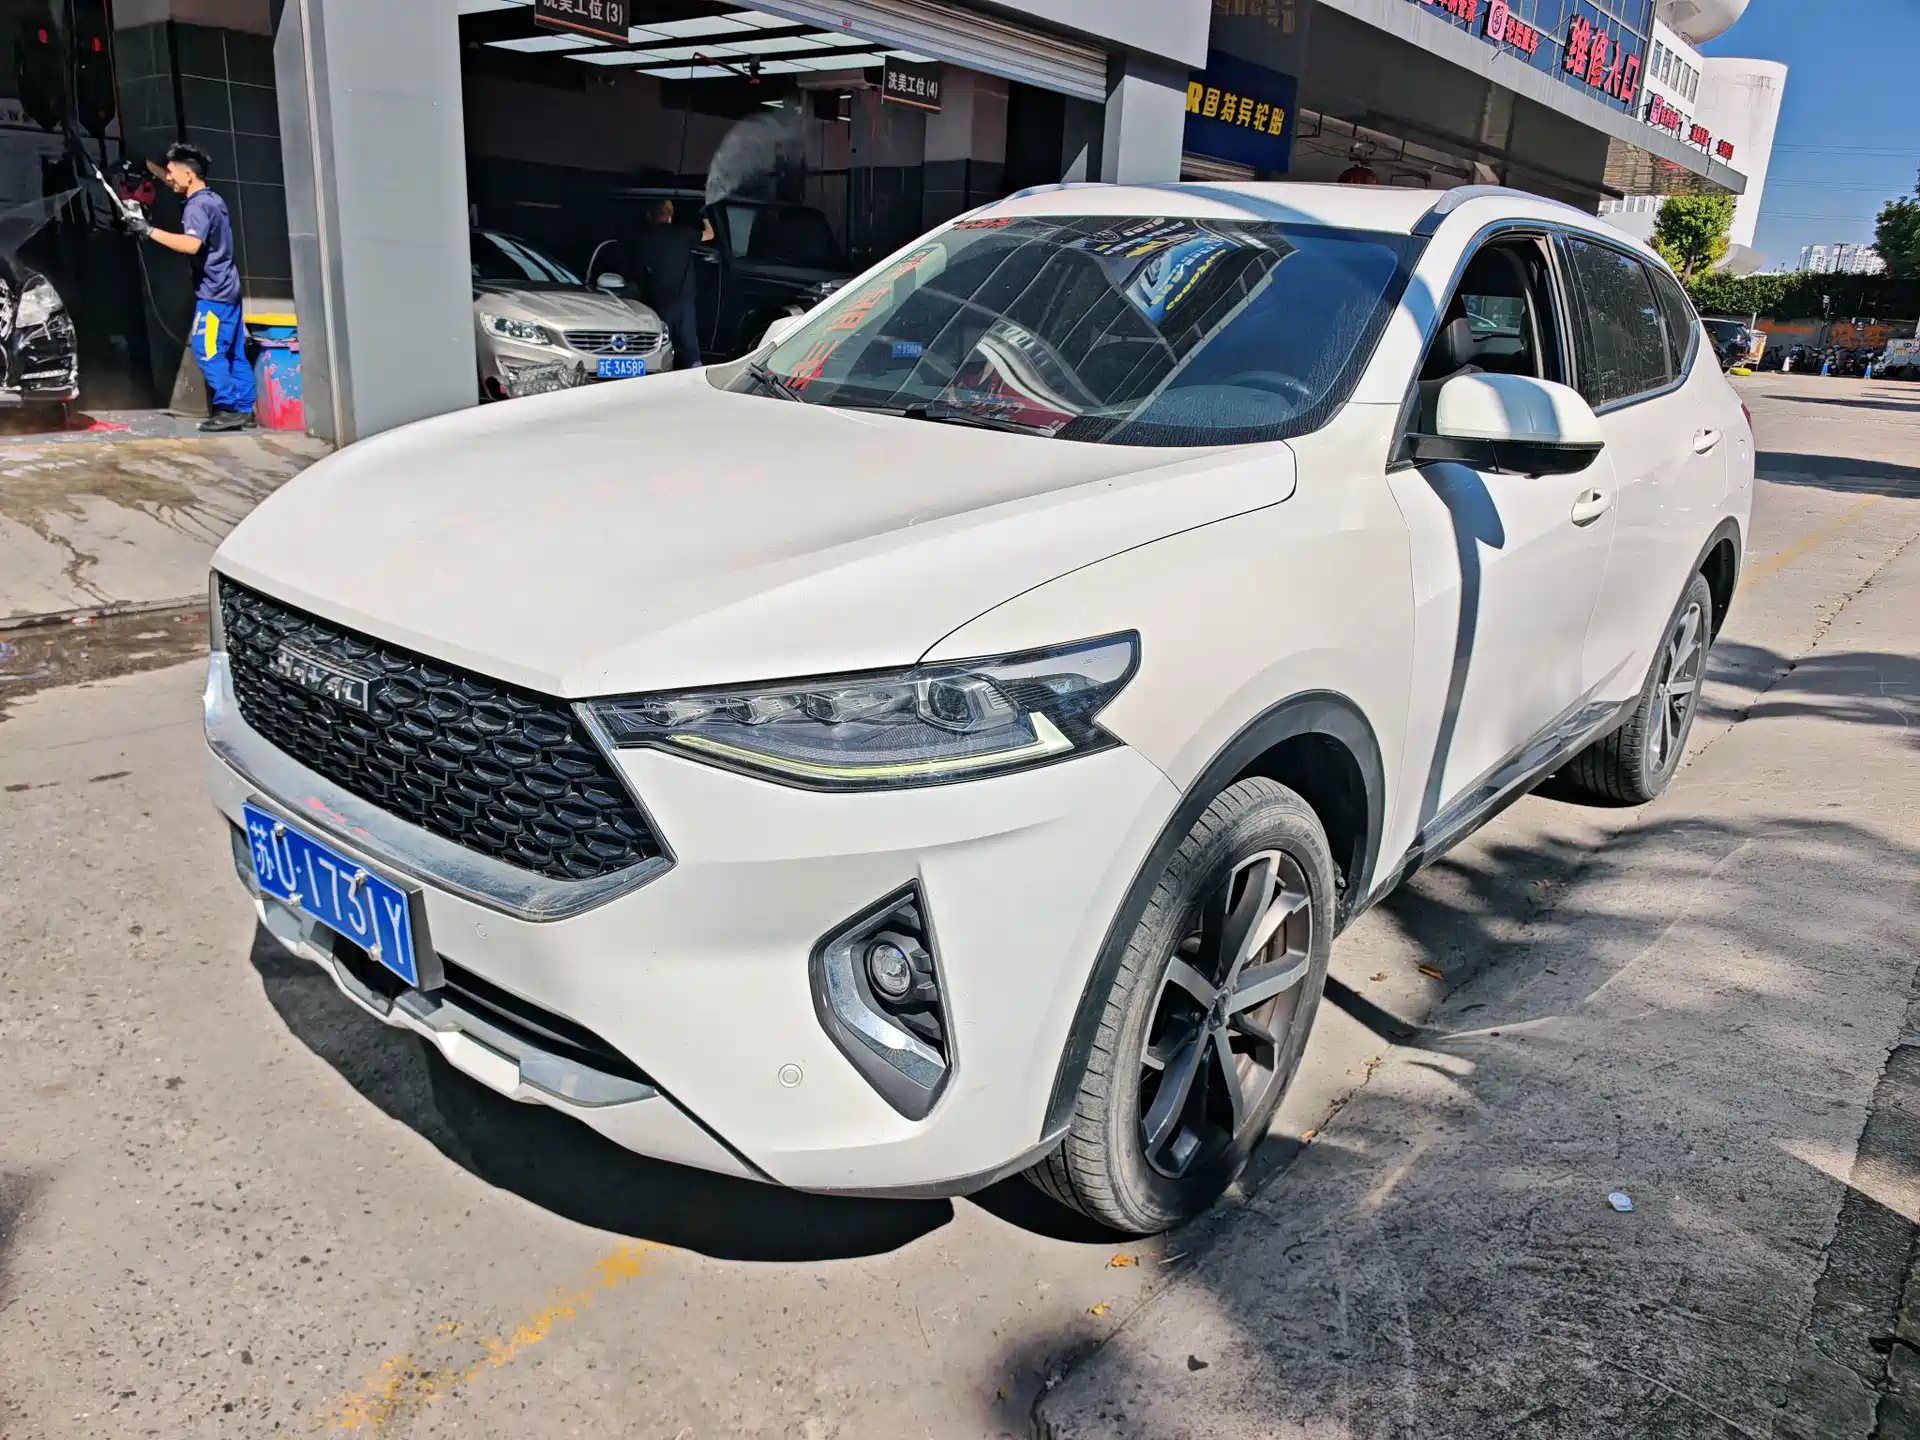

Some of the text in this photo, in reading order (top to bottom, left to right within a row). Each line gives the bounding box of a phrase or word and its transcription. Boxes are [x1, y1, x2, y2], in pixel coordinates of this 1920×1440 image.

[1566, 15, 1641, 104] 维修入口
[888, 71, 938, 100] 洗美工位(4)
[1202, 87, 1285, 136] 固特异轮胎
